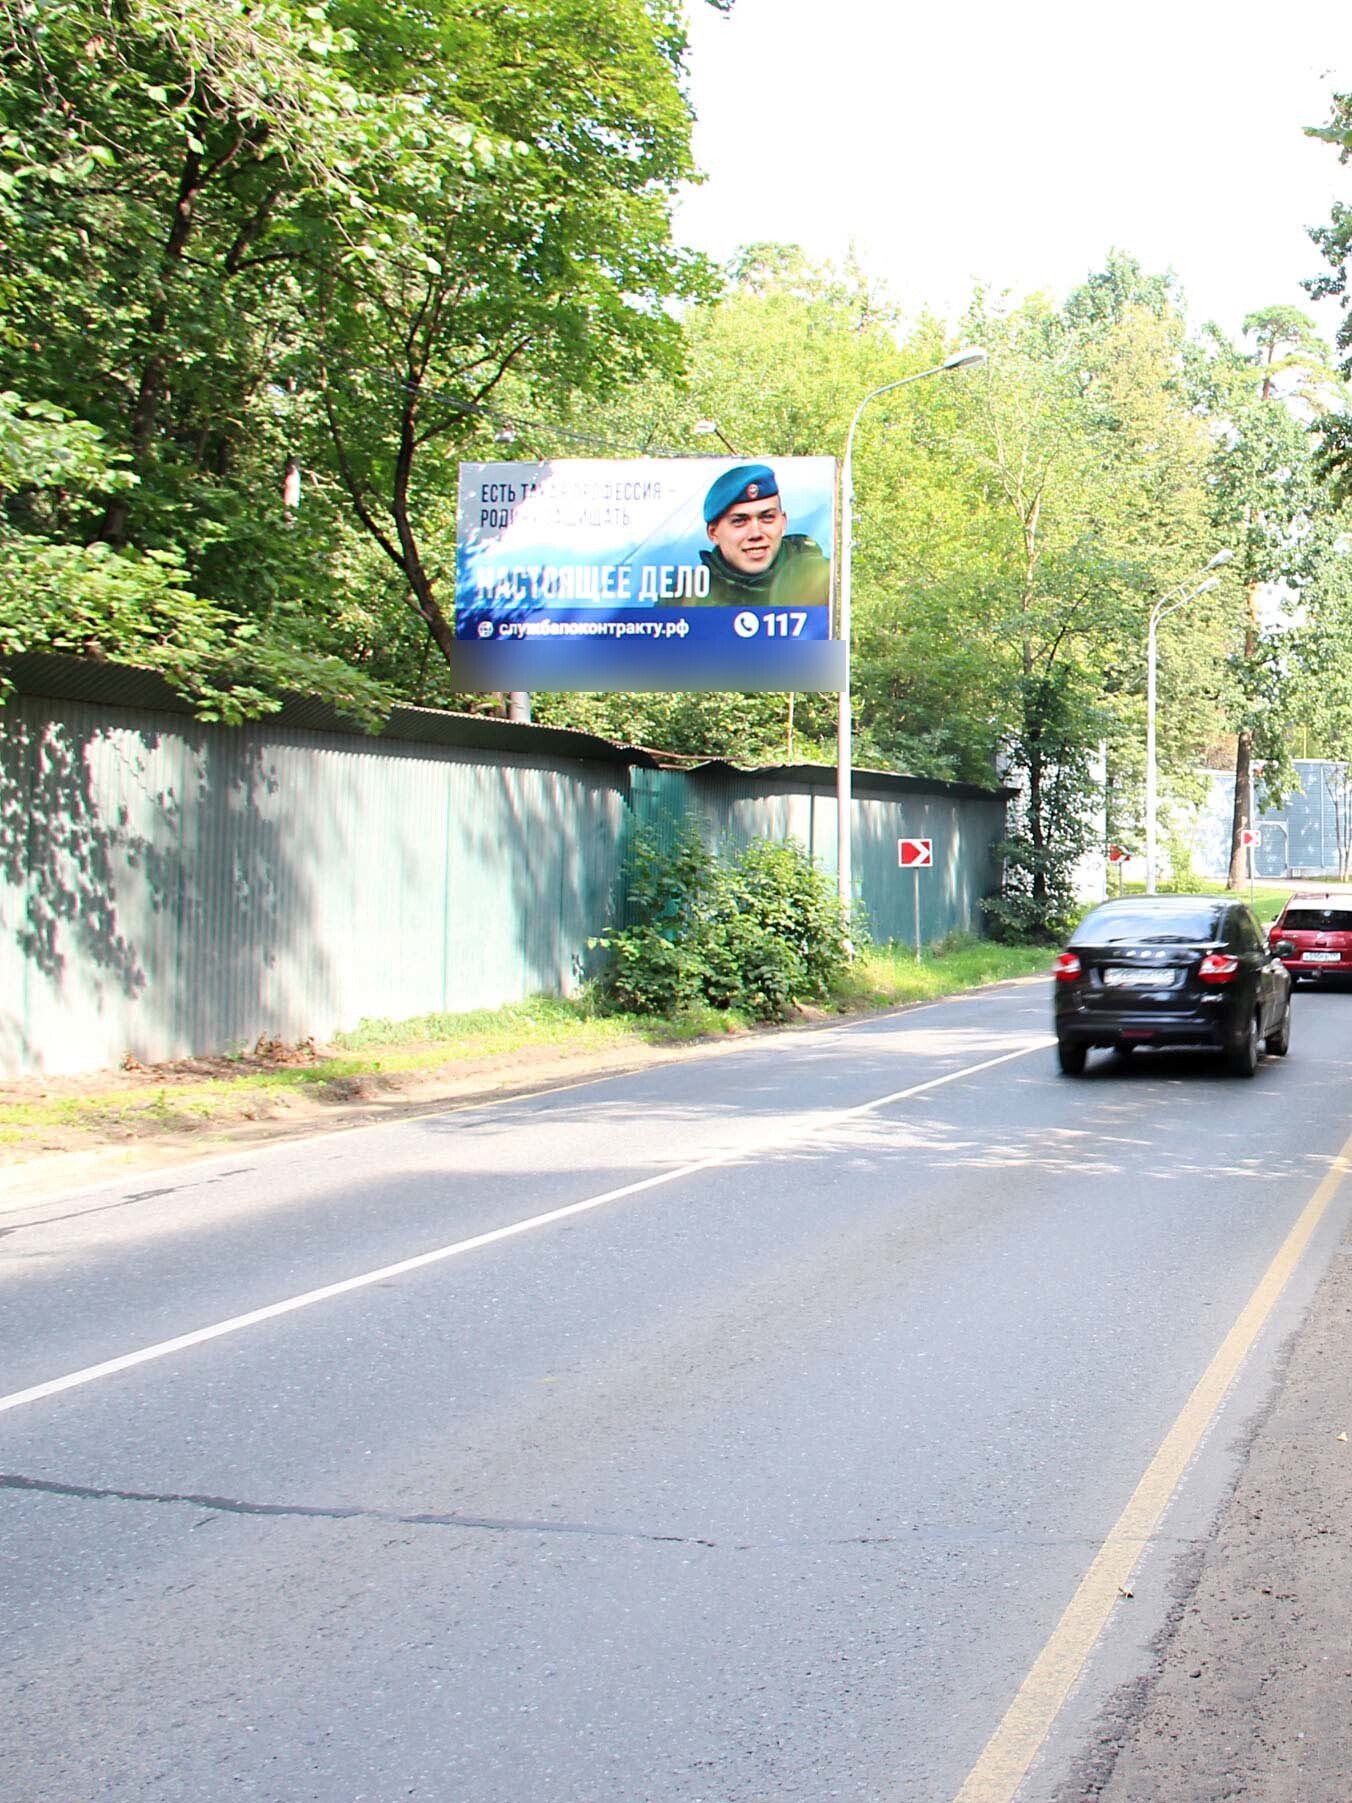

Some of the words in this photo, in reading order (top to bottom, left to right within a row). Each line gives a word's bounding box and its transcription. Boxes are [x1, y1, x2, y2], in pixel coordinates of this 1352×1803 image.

[481, 483, 516, 503] ЕСТЬ
[521, 483, 568, 502] ТАА
[574, 481, 662, 502] РОФЕССИЯ
[480, 509, 537, 529] РОДИ
[545, 508, 630, 528] АИЩАТЬ
[477, 564, 633, 602] НАСТОЯЩЕЕ
[639, 564, 711, 602] ДЕЛО
[499, 618, 690, 638] службапоконтракту.рф
[763, 612, 807, 638] 117
